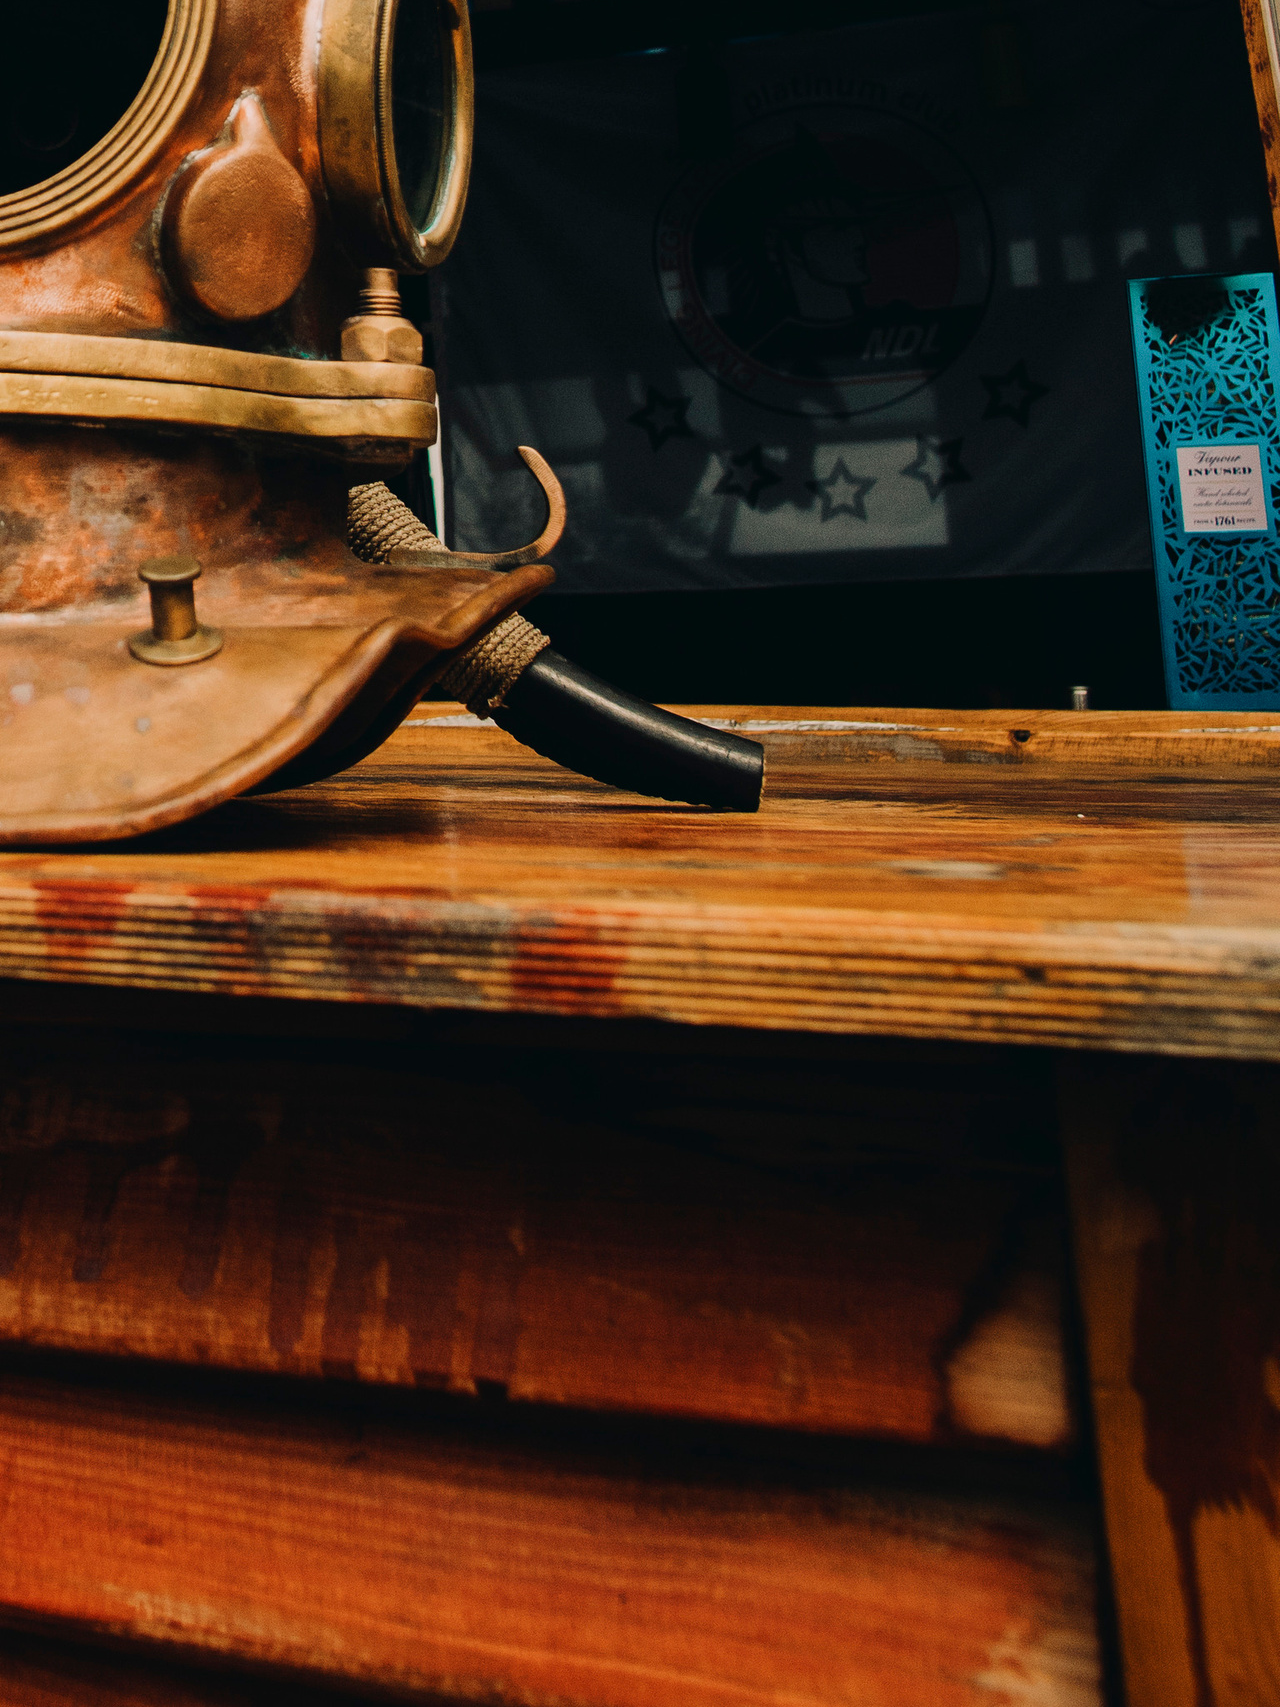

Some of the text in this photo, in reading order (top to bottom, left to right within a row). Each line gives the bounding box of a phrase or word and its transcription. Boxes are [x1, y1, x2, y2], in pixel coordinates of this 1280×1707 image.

[743, 75, 963, 134] platinum club
[861, 323, 942, 361] NDL
[1188, 466, 1252, 476] INFUSED
[1214, 515, 1236, 526] 1761
